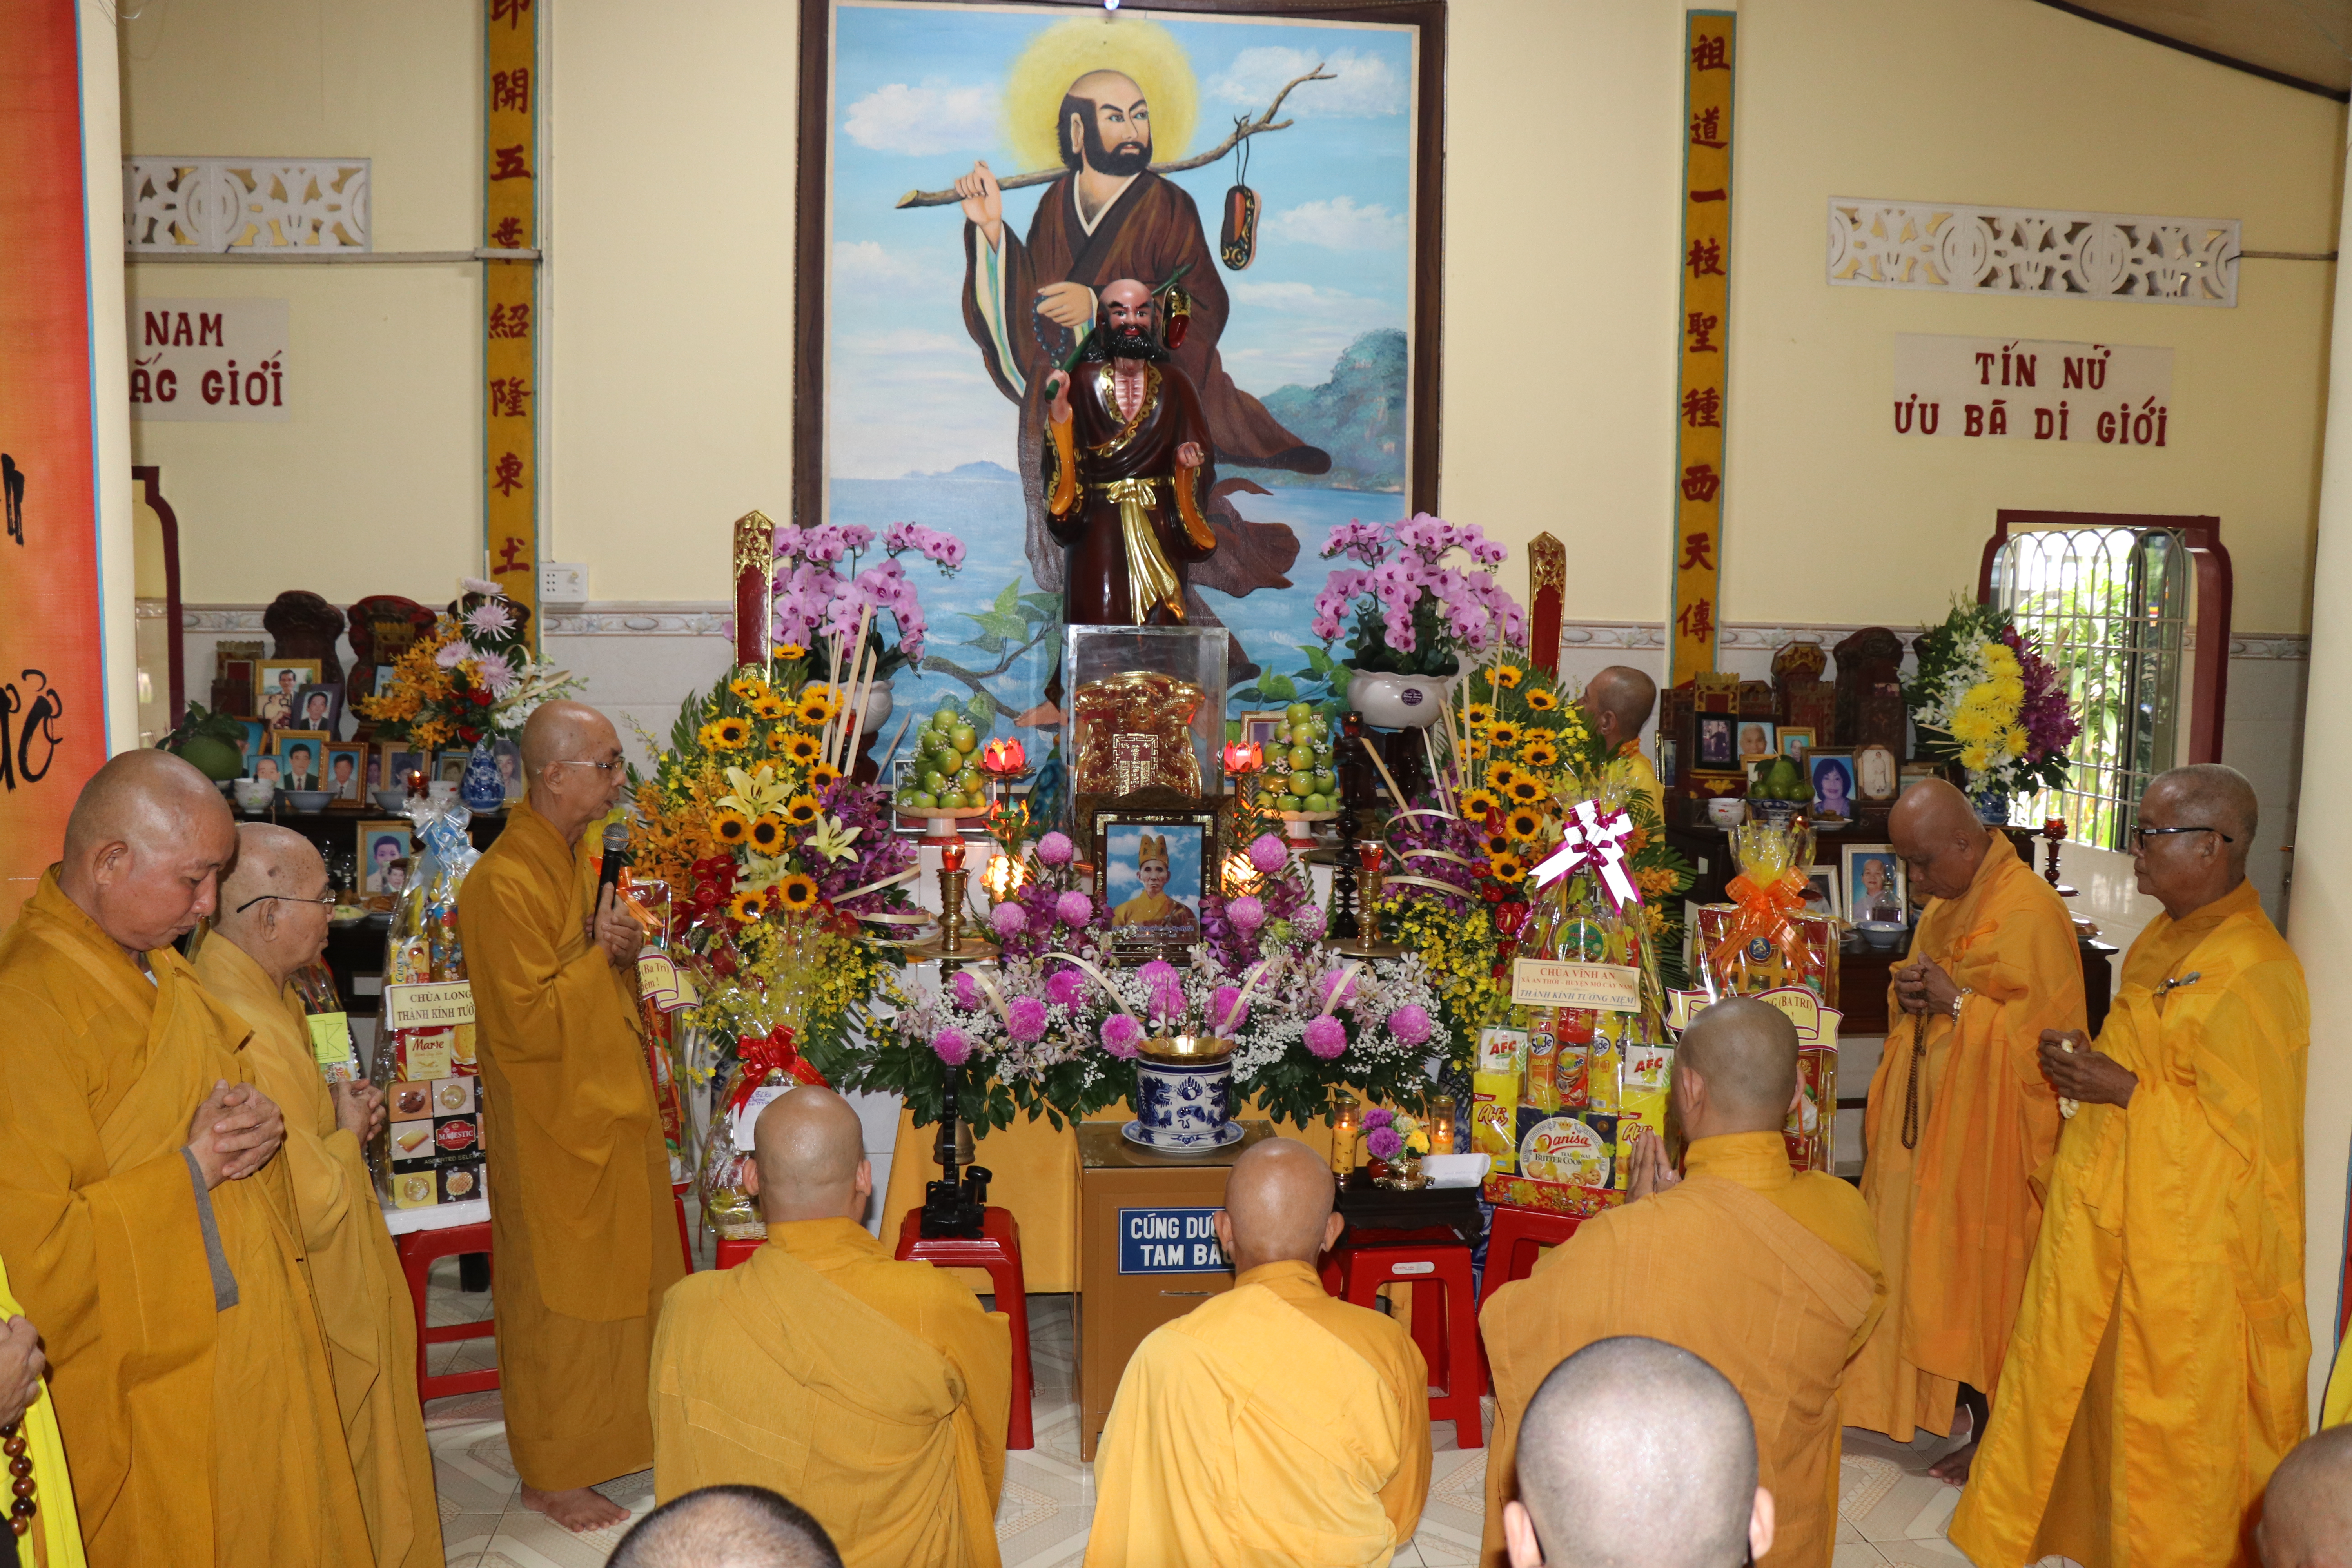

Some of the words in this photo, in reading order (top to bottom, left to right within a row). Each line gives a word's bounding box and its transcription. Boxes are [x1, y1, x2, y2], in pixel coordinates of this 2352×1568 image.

[145, 311, 223, 347] NAM
[1976, 340, 2036, 387] TÍN
[202, 350, 283, 406] GIỚI
[1894, 393, 1939, 435] ƯU
[2034, 400, 2069, 440] DI
[2097, 396, 2167, 446] GIỚI
[641, 964, 653, 977] (Ba
[655, 963, 670, 974] Tri)
[1540, 966, 1570, 977] CHÙA
[1573, 968, 1598, 979] VĨNH
[410, 992, 441, 1002] CHÙA
[444, 990, 472, 1001] LONG
[1520, 989, 1550, 998] THÀNH
[1552, 990, 1574, 1000] KÍNH
[1610, 996, 1634, 1005] NIỆM
[1779, 996, 1792, 1009] (BA
[1794, 996, 1812, 1011] TRI)
[397, 1007, 429, 1021] THÀNH
[432, 1006, 454, 1019] KÍNH
[412, 1038, 444, 1051] Marie
[1489, 1040, 1517, 1055] AFC
[1634, 1057, 1663, 1073] AFC
[1535, 1153, 1562, 1164] BUTTER
[1563, 1157, 1583, 1165] COOK
[1131, 1213, 1180, 1239] CÚNG
[1140, 1244, 1184, 1266] TAM
